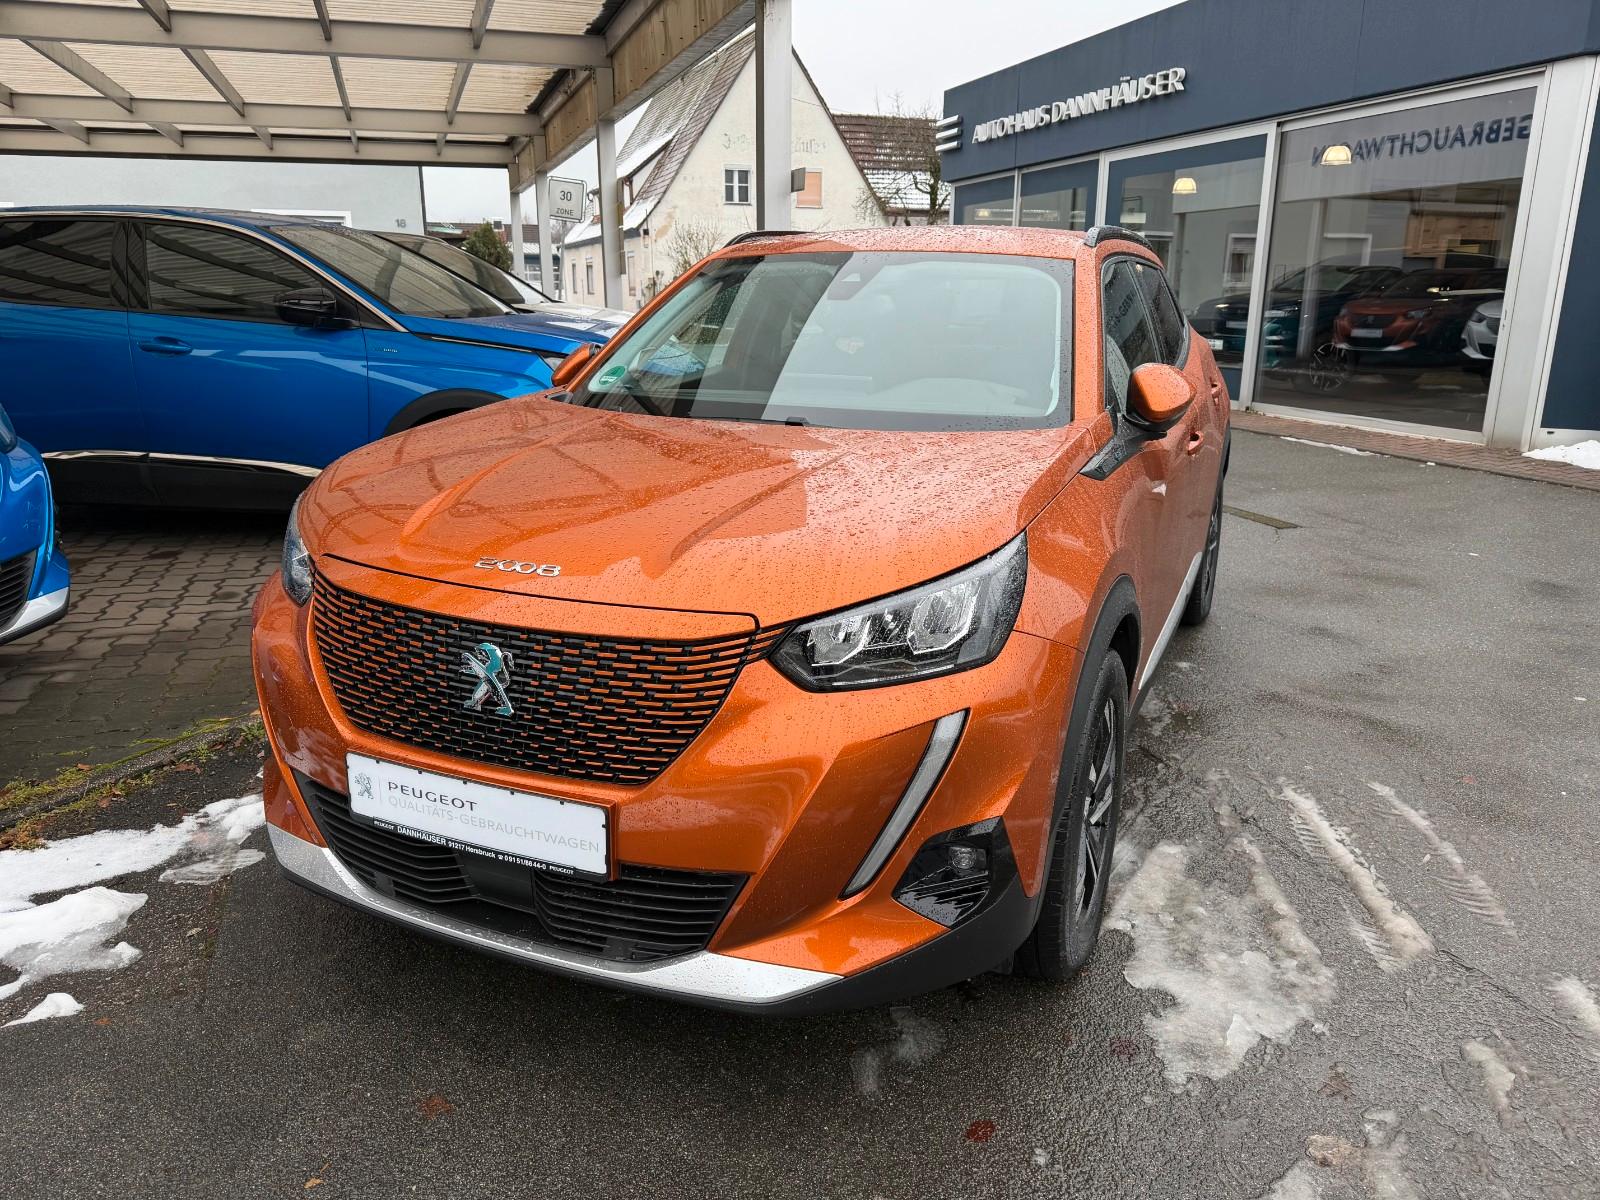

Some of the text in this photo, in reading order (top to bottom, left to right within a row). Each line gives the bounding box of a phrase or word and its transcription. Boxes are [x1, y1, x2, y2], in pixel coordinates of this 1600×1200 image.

[971, 67, 1187, 144] AUTOHAUS DANNHÄUSER
[559, 190, 572, 202] 30
[556, 207, 575, 217] ZONE
[395, 218, 406, 229] 18
[474, 556, 561, 577] 2008
[387, 781, 478, 812] PEUGEOT
[387, 795, 600, 853] QUALITÄTS-GEBRAUCHTWAGEN
[448, 840, 465, 851] 91217
